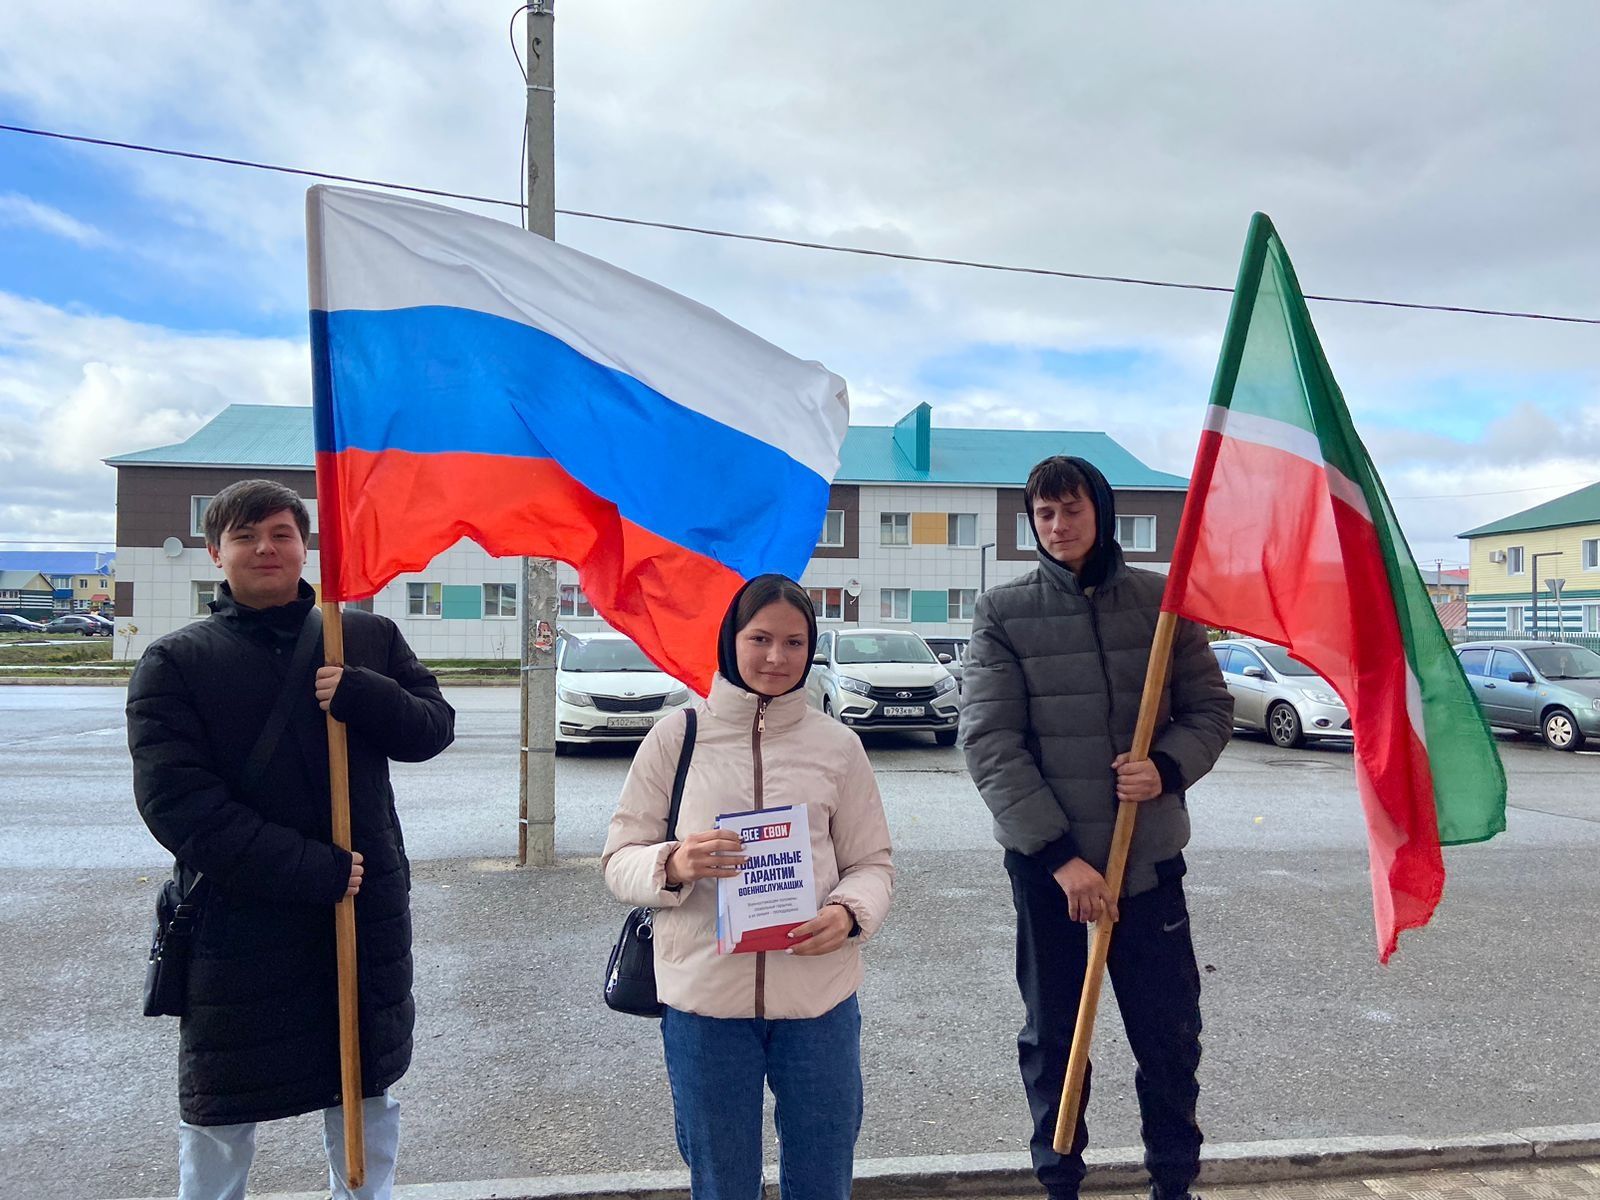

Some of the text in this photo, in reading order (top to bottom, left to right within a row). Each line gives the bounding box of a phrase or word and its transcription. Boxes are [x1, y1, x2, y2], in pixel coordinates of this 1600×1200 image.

[742, 824, 788, 841] ВСЕ СВОИ
[735, 850, 802, 870] ОЦИАЛЬНЫЕ
[744, 866, 795, 885] ГАРАНТИИ
[738, 880, 804, 897] ВОЕННОСЛУЖАЩИХ
